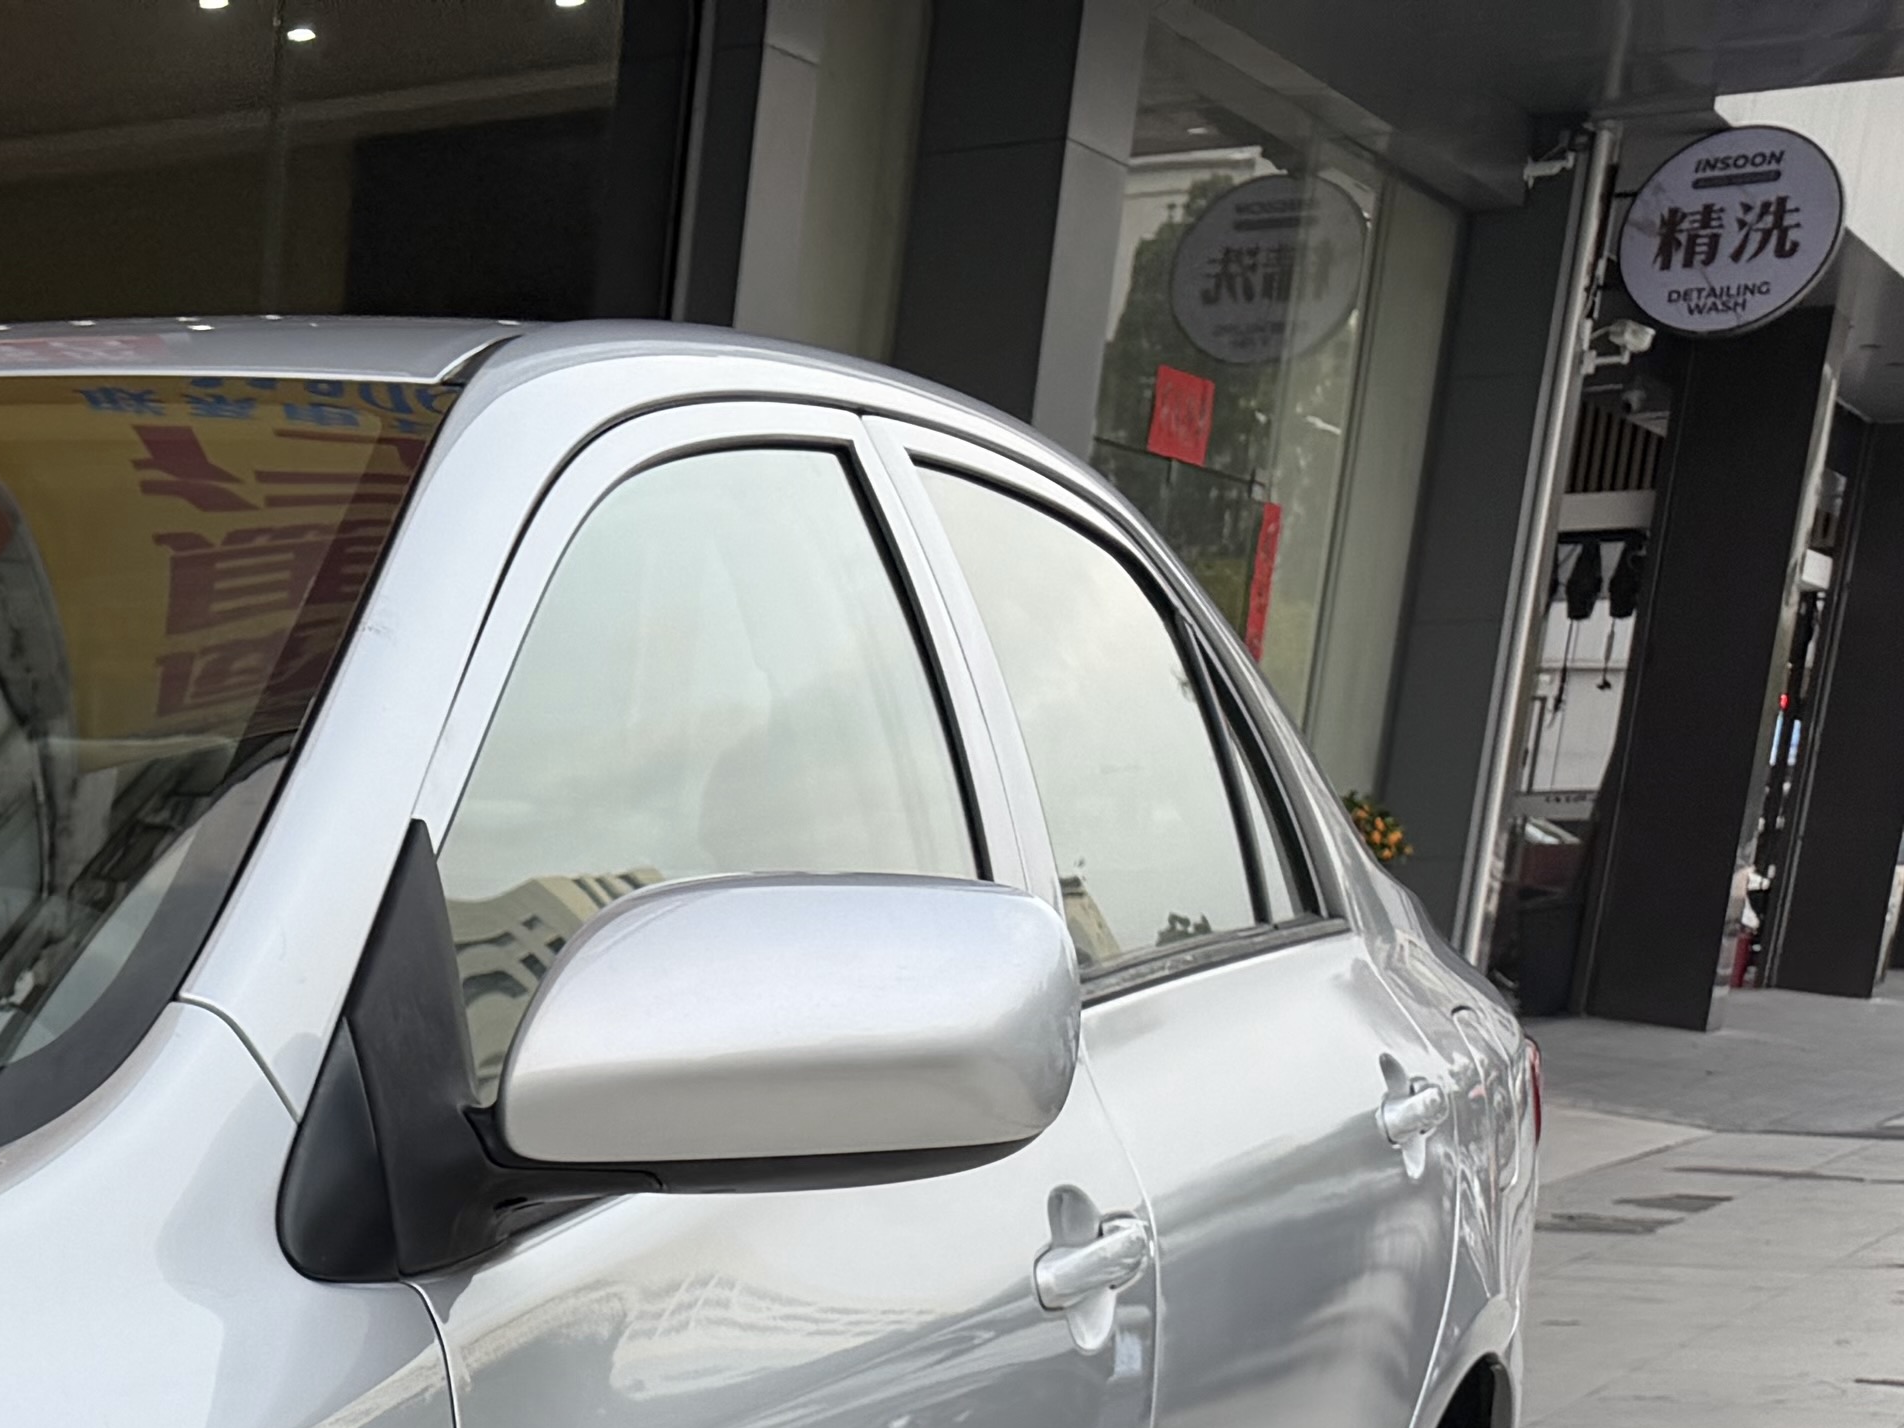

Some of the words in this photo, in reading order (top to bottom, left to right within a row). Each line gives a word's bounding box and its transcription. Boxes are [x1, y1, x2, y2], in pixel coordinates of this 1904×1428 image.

[1694, 150, 1785, 174] INSOON
[1652, 195, 1802, 271] 精洗
[1667, 281, 1772, 304] DETAILING
[1687, 300, 1747, 316] WASH
